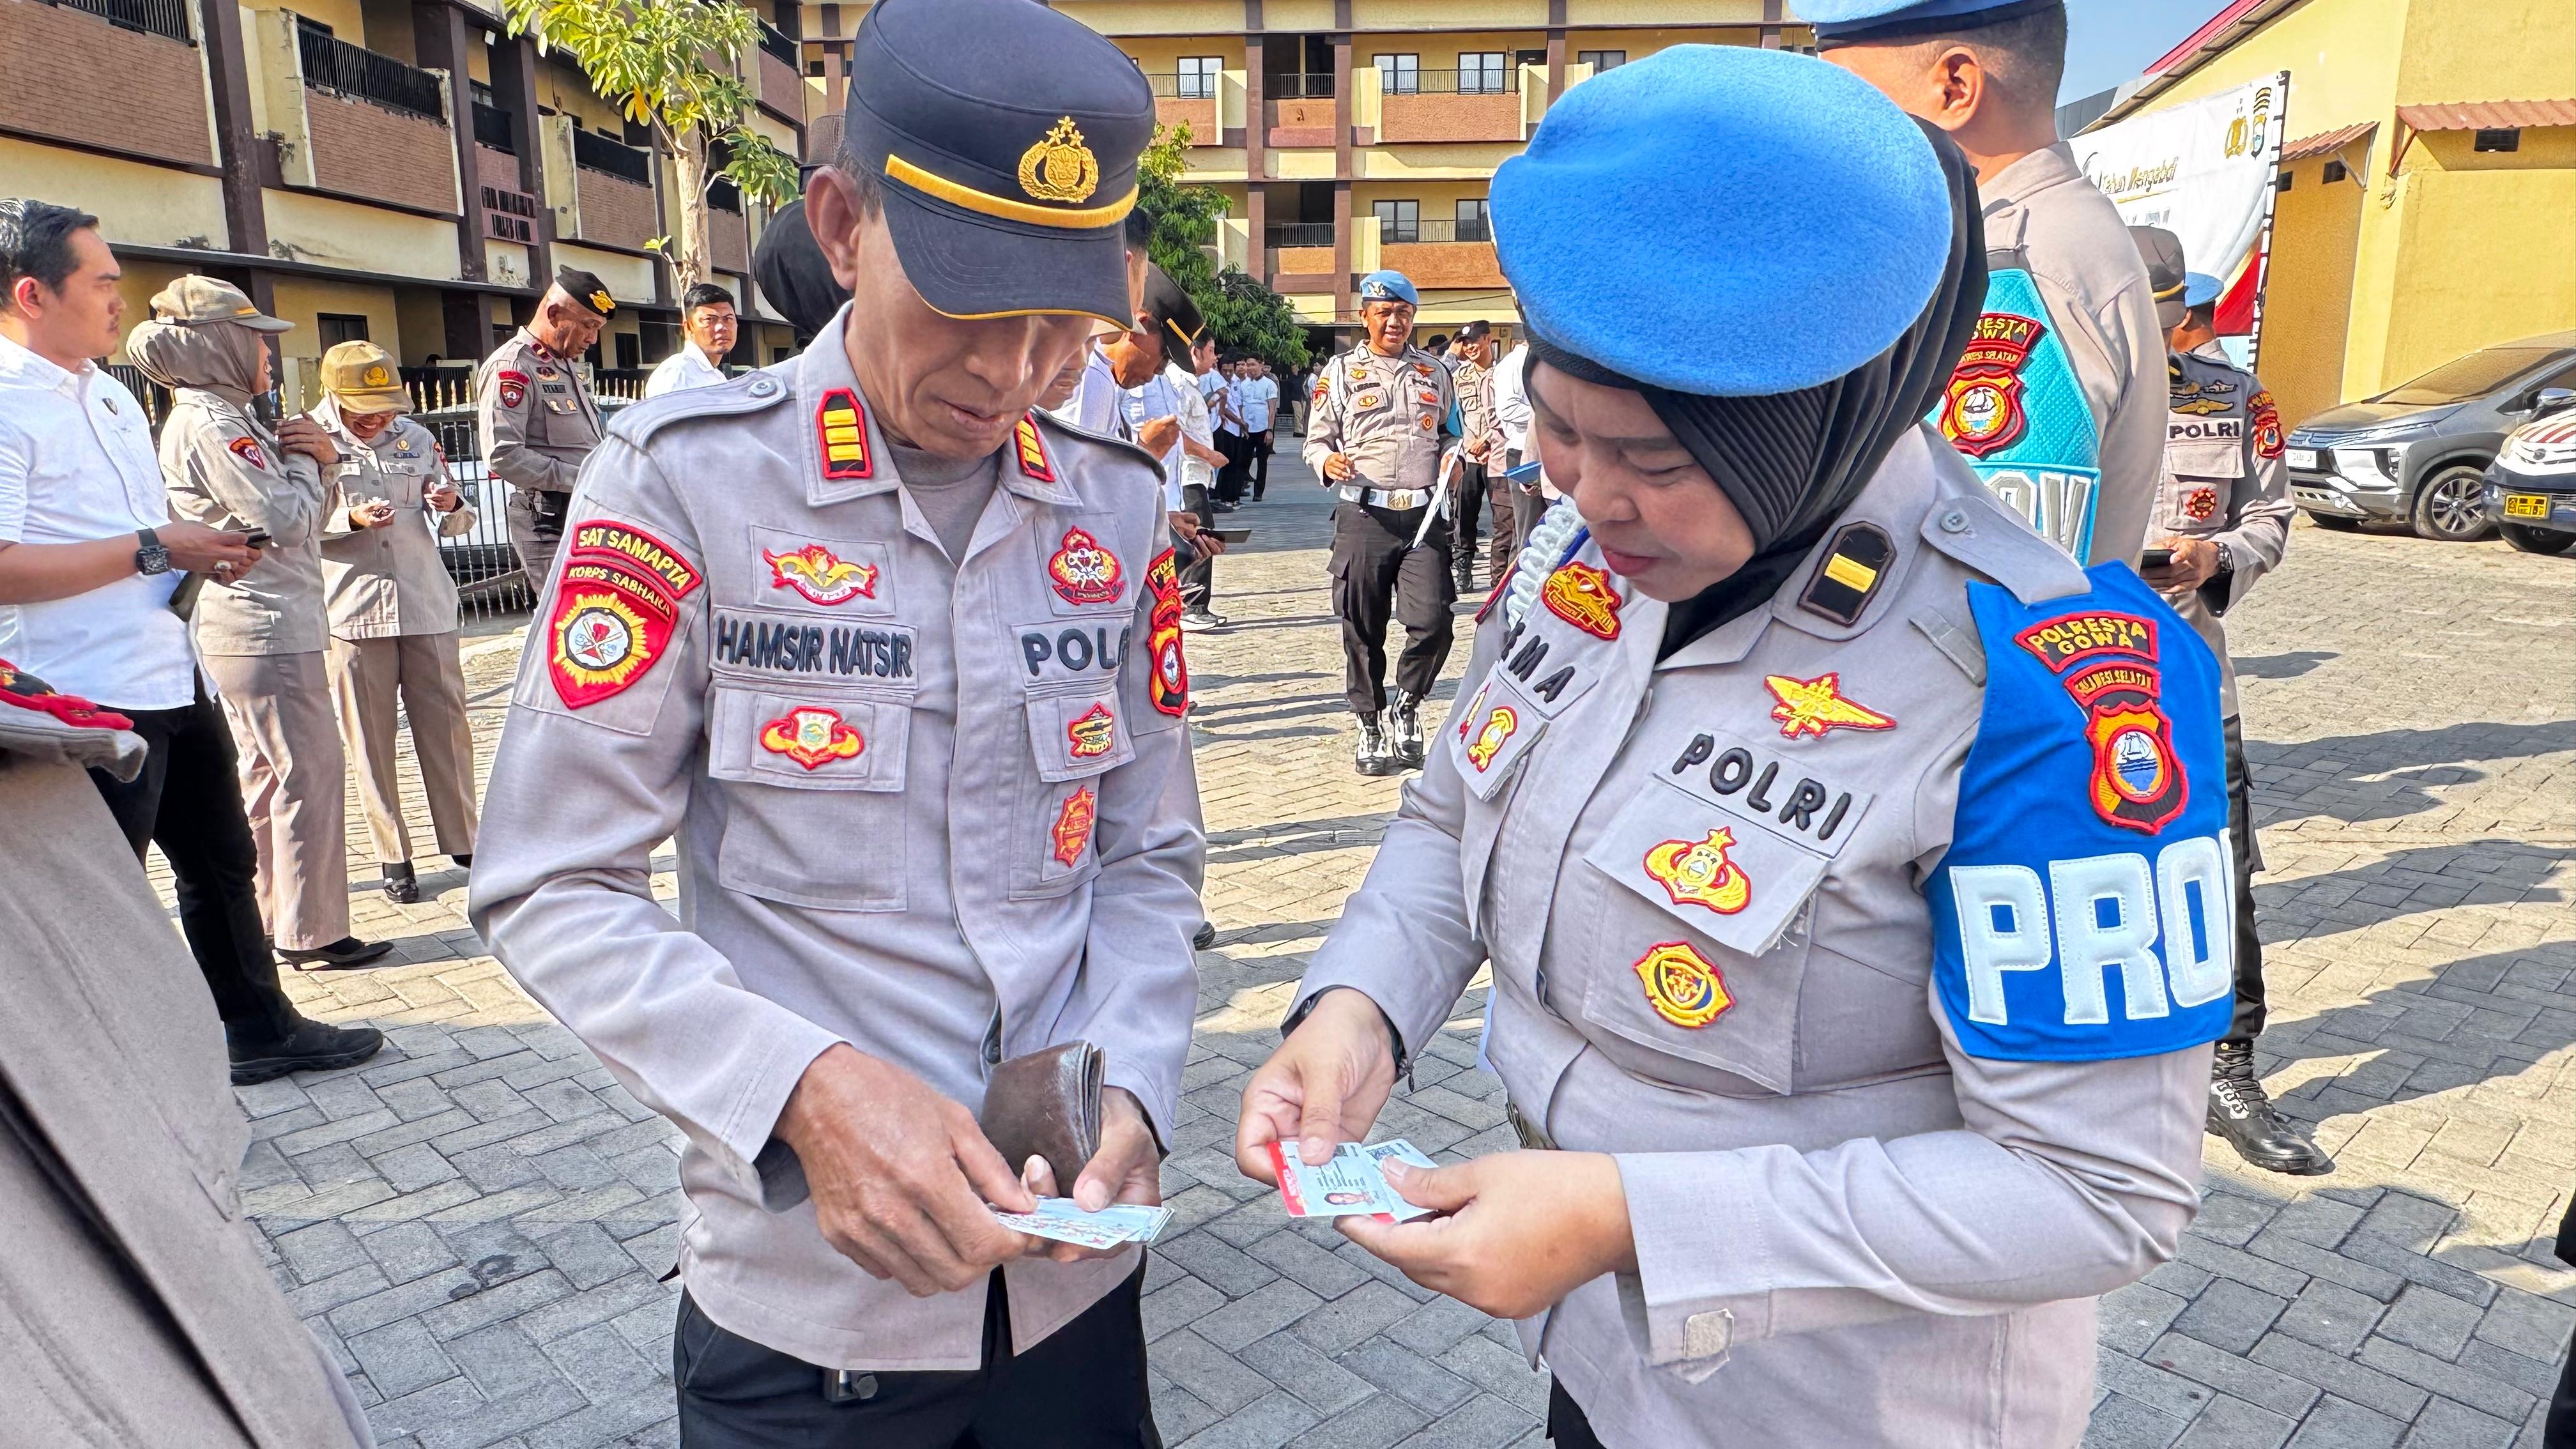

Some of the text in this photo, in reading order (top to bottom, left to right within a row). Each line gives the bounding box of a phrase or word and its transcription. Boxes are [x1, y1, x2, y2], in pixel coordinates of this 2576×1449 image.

[2169, 422, 2239, 439] POLRI
[578, 527, 691, 590] SAT SAMAPTA
[568, 566, 671, 616] KORPS SABHARA
[717, 612, 912, 678] HAMSIR NATSIR
[2027, 617, 2148, 653] POLRESTA
[2058, 632, 2134, 655] GOWA
[1671, 733, 1851, 841] POLRI
[1949, 827, 2235, 1025] PRO
